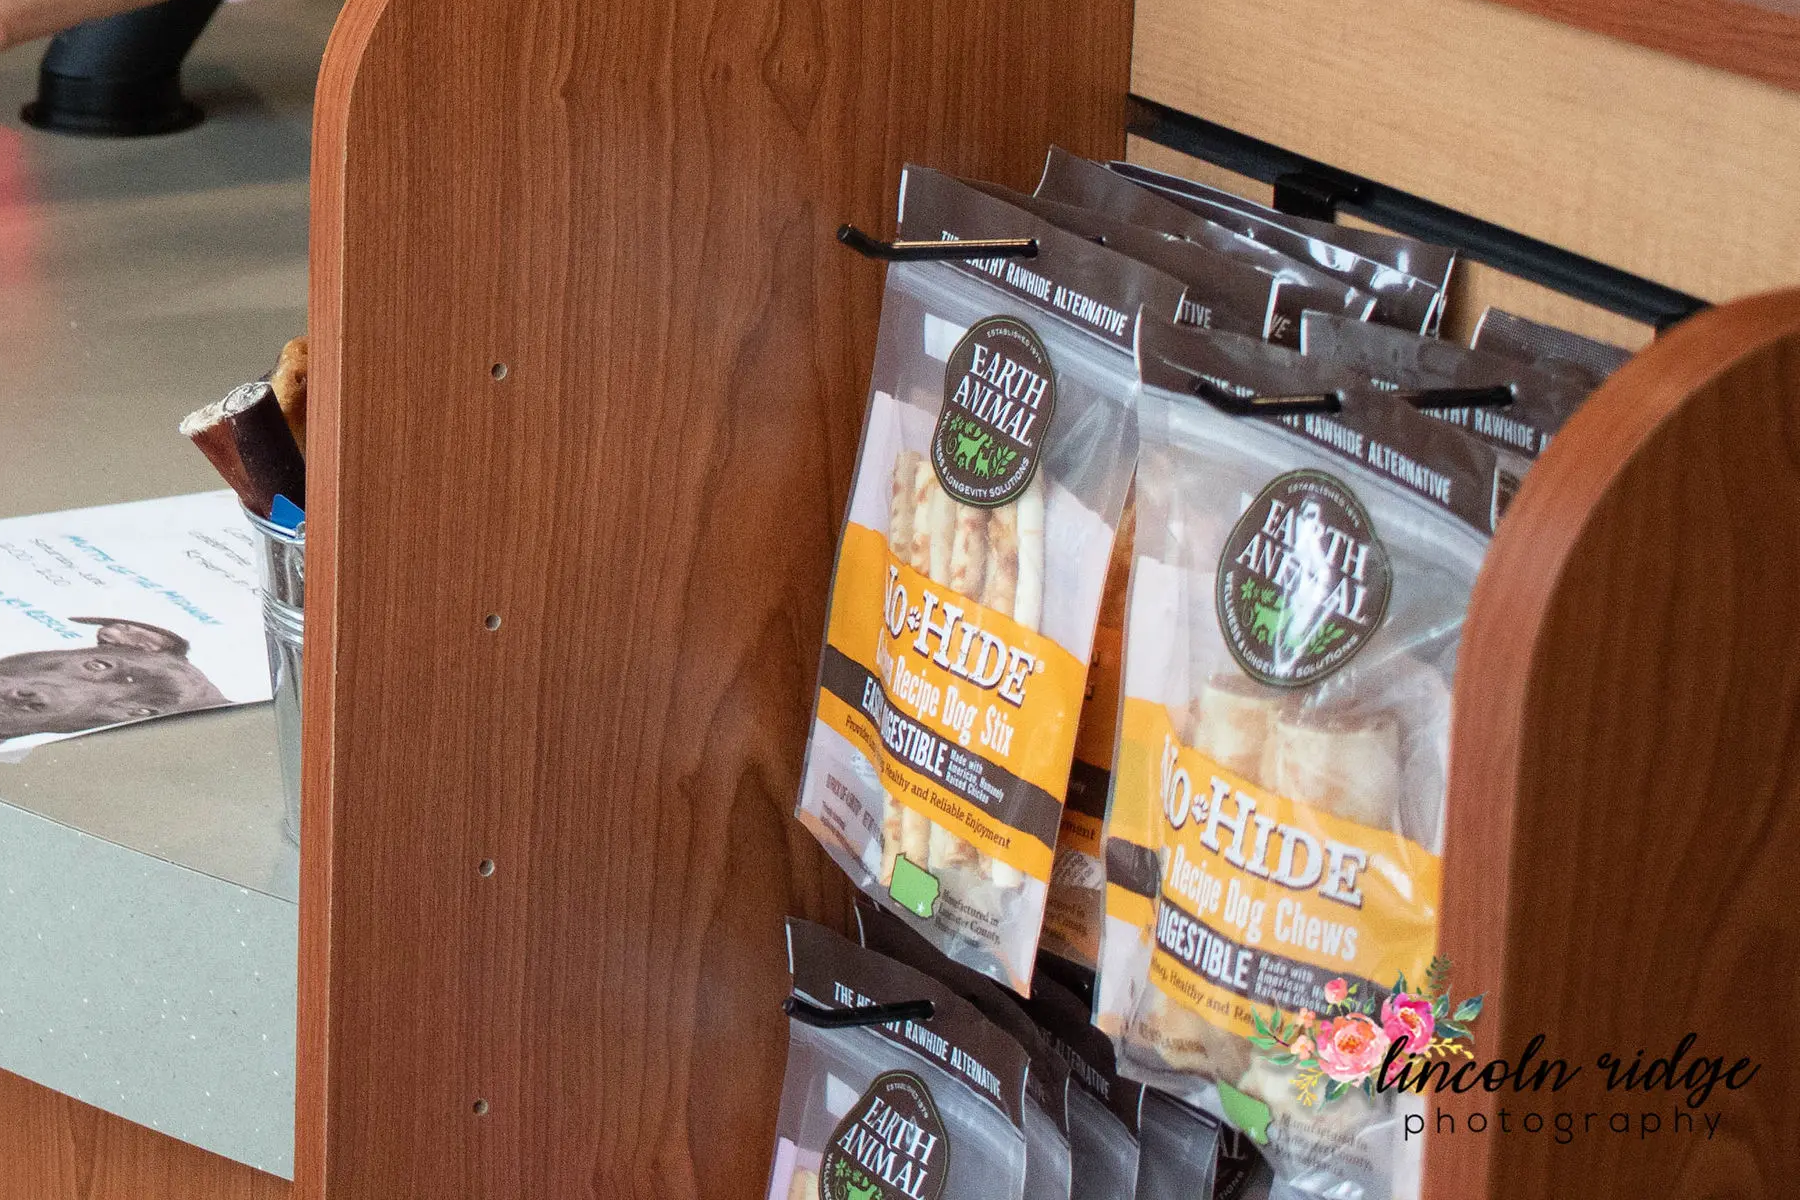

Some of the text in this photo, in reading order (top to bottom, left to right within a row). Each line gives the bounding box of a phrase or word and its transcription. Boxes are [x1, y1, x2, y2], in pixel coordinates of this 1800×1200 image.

[1006, 262, 1052, 302] RAWHIDE
[1053, 285, 1129, 337] ALTERNATIVE
[952, 375, 1036, 447] ANIMAL
[969, 343, 1048, 410] EARTH
[1304, 413, 1451, 504] RAWHIDE ALTERNATIVE
[1474, 411, 1535, 450] RAWHIDE
[944, 472, 988, 498] LONGEVITY
[989, 456, 1030, 498] SOLUTIONS
[893, 655, 940, 720] Recipe
[942, 685, 978, 746] Dog
[981, 703, 1014, 757] Stix
[950, 749, 983, 774] Made with
[884, 764, 1012, 849] Healthy and Reliable Enjoyment
[1169, 844, 1223, 916] Recipe
[1223, 877, 1266, 945] Dog
[1274, 897, 1358, 961] Chews
[1169, 970, 1204, 1004] Healthy
[1206, 996, 1230, 1016] and
[1290, 963, 1314, 982] with
[905, 1020, 949, 1061] RAWHIDE
[951, 1047, 1001, 1100] ALTERNATIVE
[861, 1096, 939, 1166] EARTH
